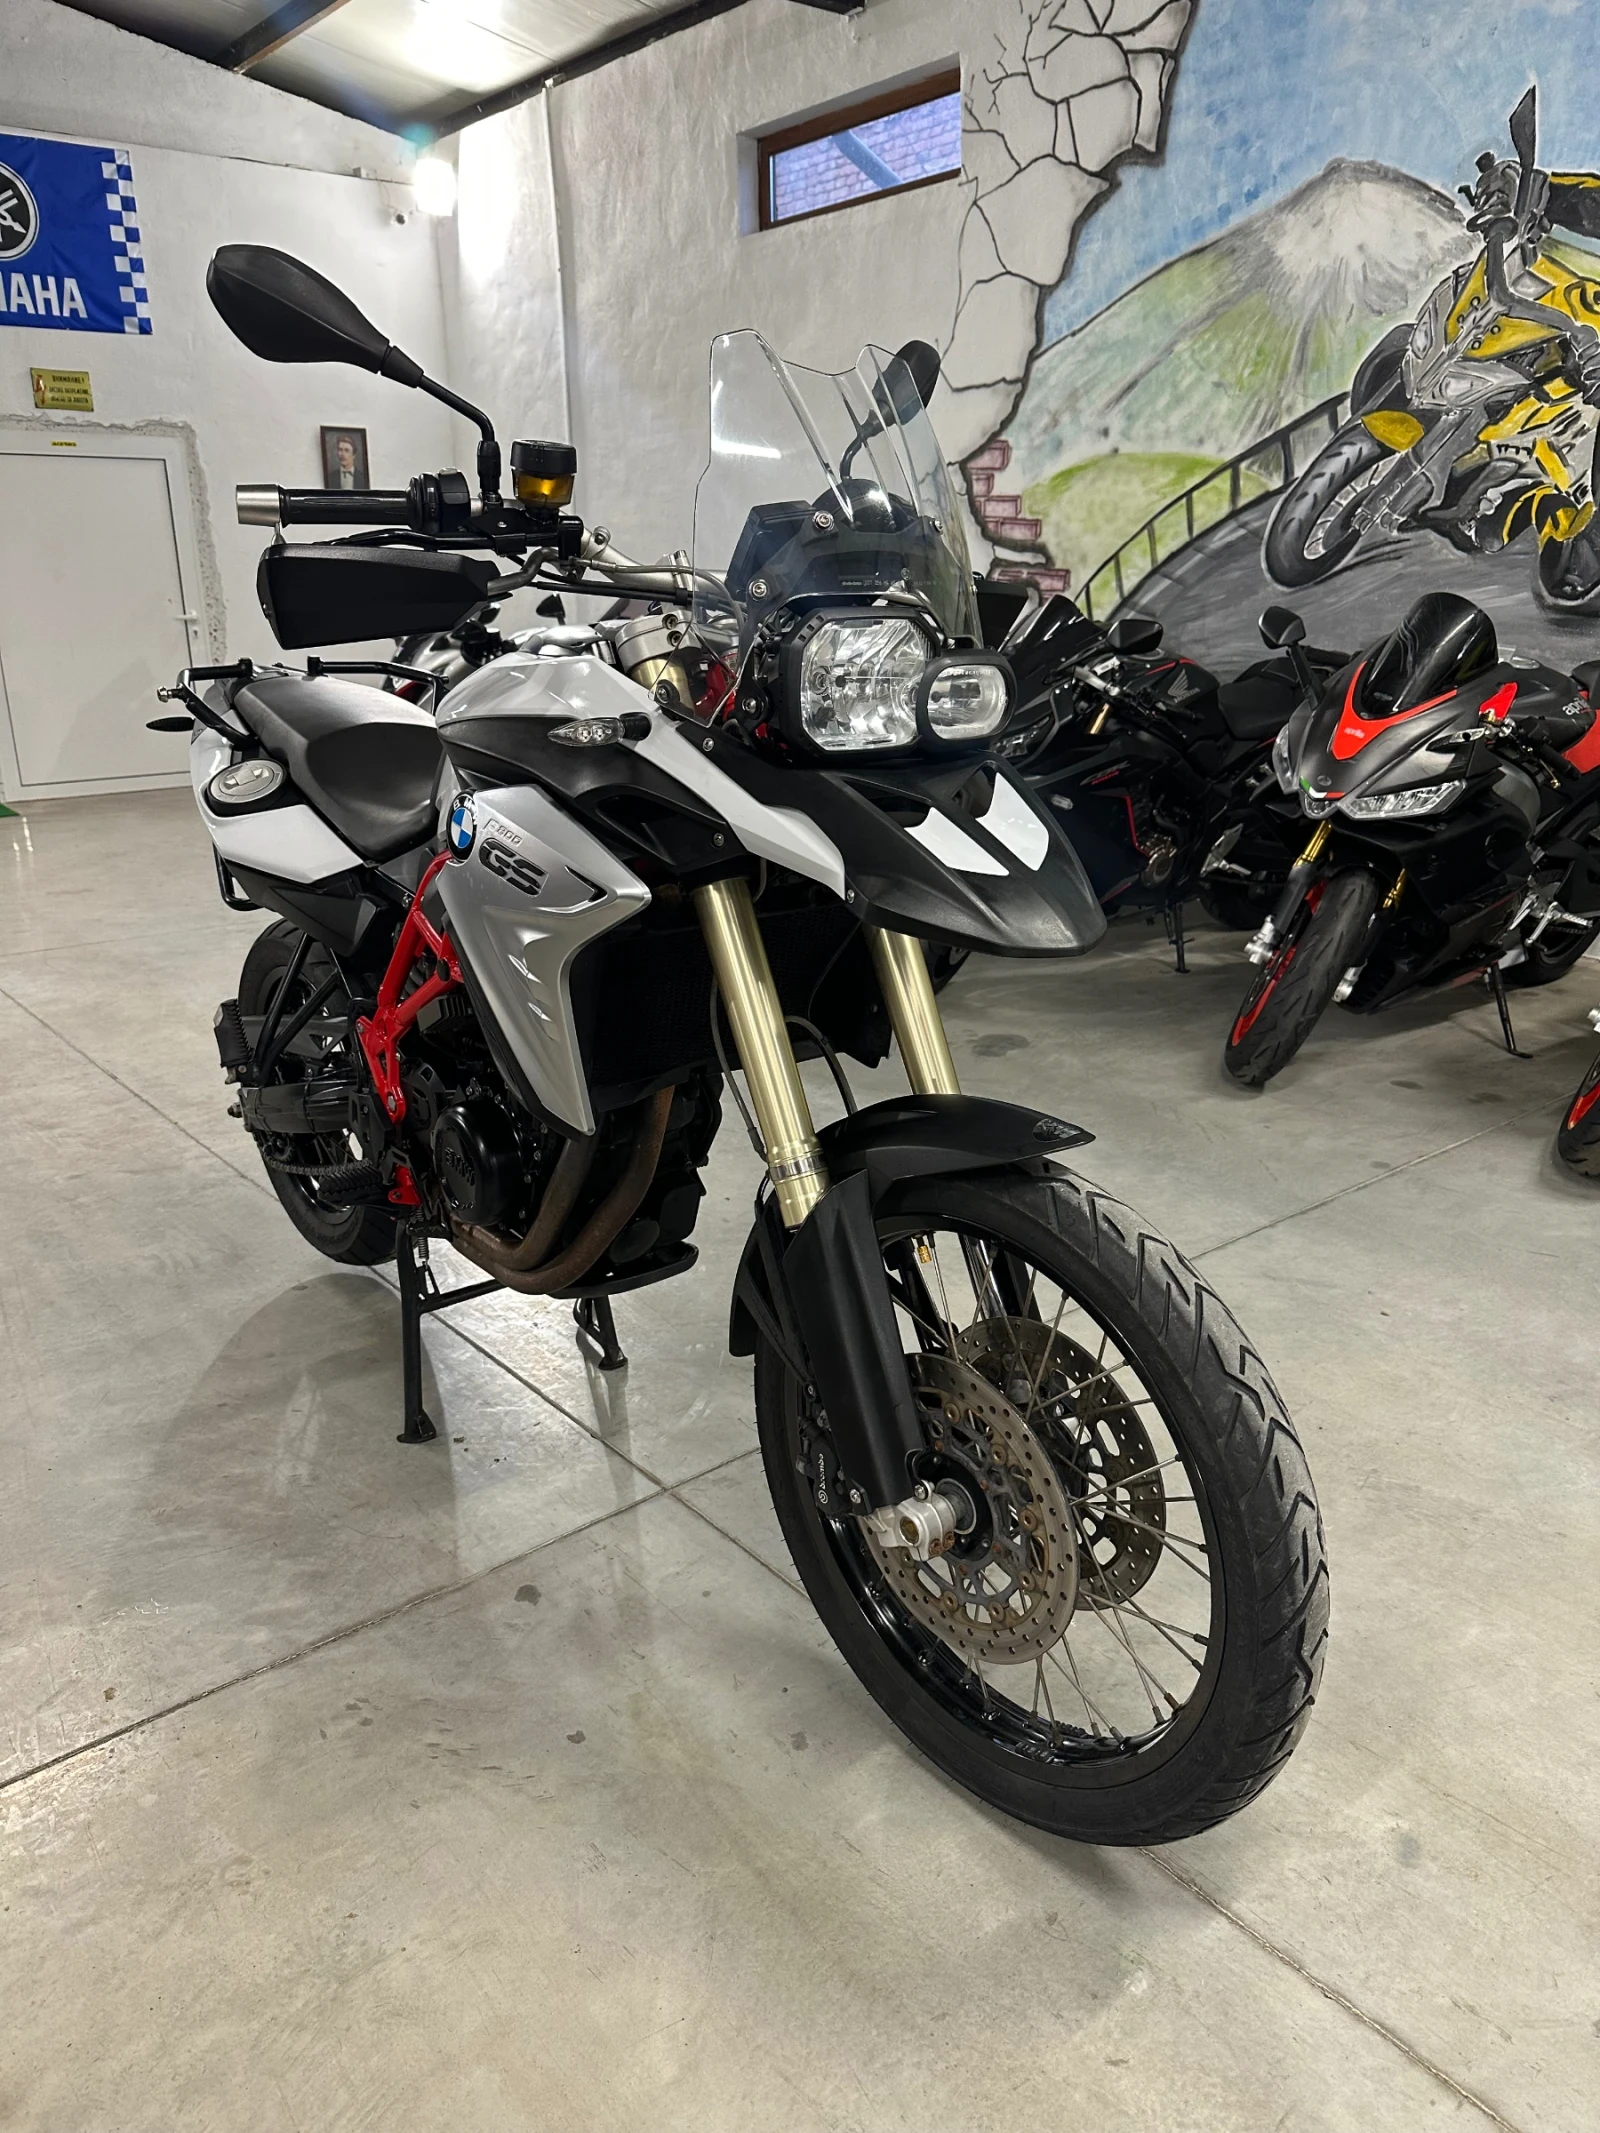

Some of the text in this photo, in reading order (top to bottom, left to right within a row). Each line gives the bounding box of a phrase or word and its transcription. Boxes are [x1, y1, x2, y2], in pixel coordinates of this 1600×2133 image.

[1173, 687, 1200, 703] HONDA
[479, 838, 548, 897] GS
[444, 1146, 476, 1187] BMW
